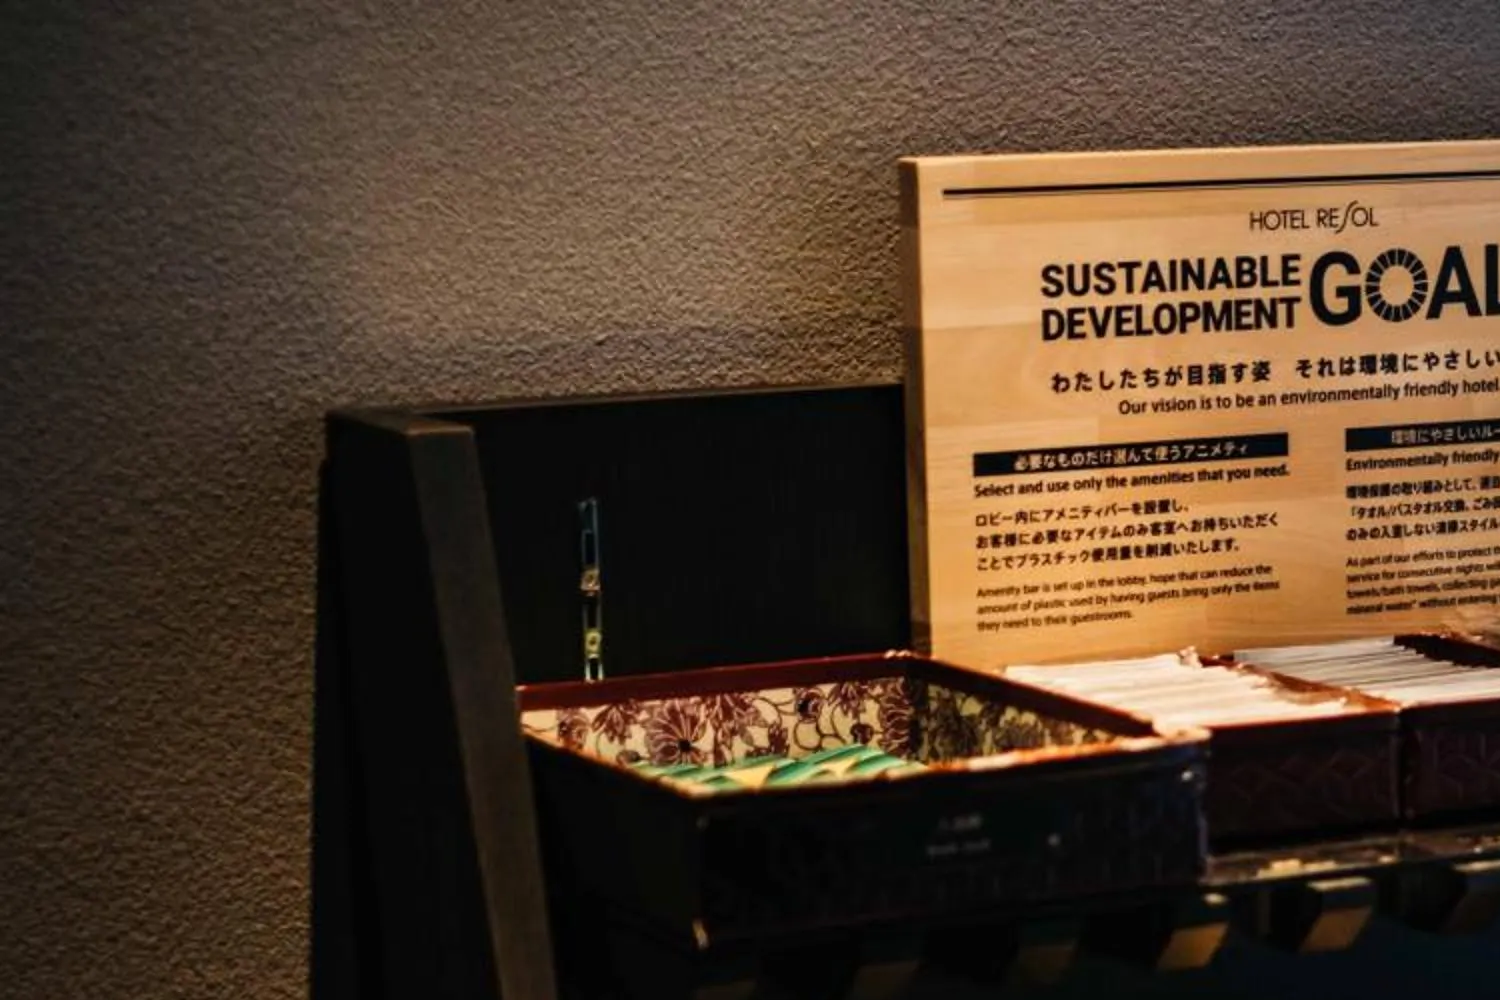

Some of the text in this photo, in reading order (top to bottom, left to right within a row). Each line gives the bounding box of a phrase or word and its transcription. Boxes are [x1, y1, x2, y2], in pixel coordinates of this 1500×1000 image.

[1250, 200, 1379, 234] HOTEL RESOL
[1041, 254, 1301, 298] SUSTAINABLE
[1042, 296, 1302, 341] DEVELOPMENT
[1051, 360, 1271, 394] わたしたちが目指す姿
[1118, 400, 1147, 415] Our
[1151, 398, 1196, 413] vision
[1201, 397, 1213, 411] is
[1216, 396, 1231, 409] to
[1236, 393, 1254, 408] be
[1259, 394, 1277, 407] an
[1281, 383, 1400, 405] environmentally
[1403, 378, 1458, 398] friendly
[1346, 451, 1449, 471] Environmentally
[1452, 449, 1499, 464] friendly
[974, 464, 1290, 498] Select and use only the amenities that you need.
[1098, 577, 1115, 588] the
[1178, 571, 1198, 581] that
[1200, 570, 1218, 579] can
[1220, 565, 1253, 577] reduce
[1255, 564, 1273, 574] the
[1020, 600, 1032, 611] of
[1110, 591, 1145, 605] having
[1148, 589, 1180, 603] guests
[1211, 584, 1232, 597] only
[1235, 582, 1251, 592] the
